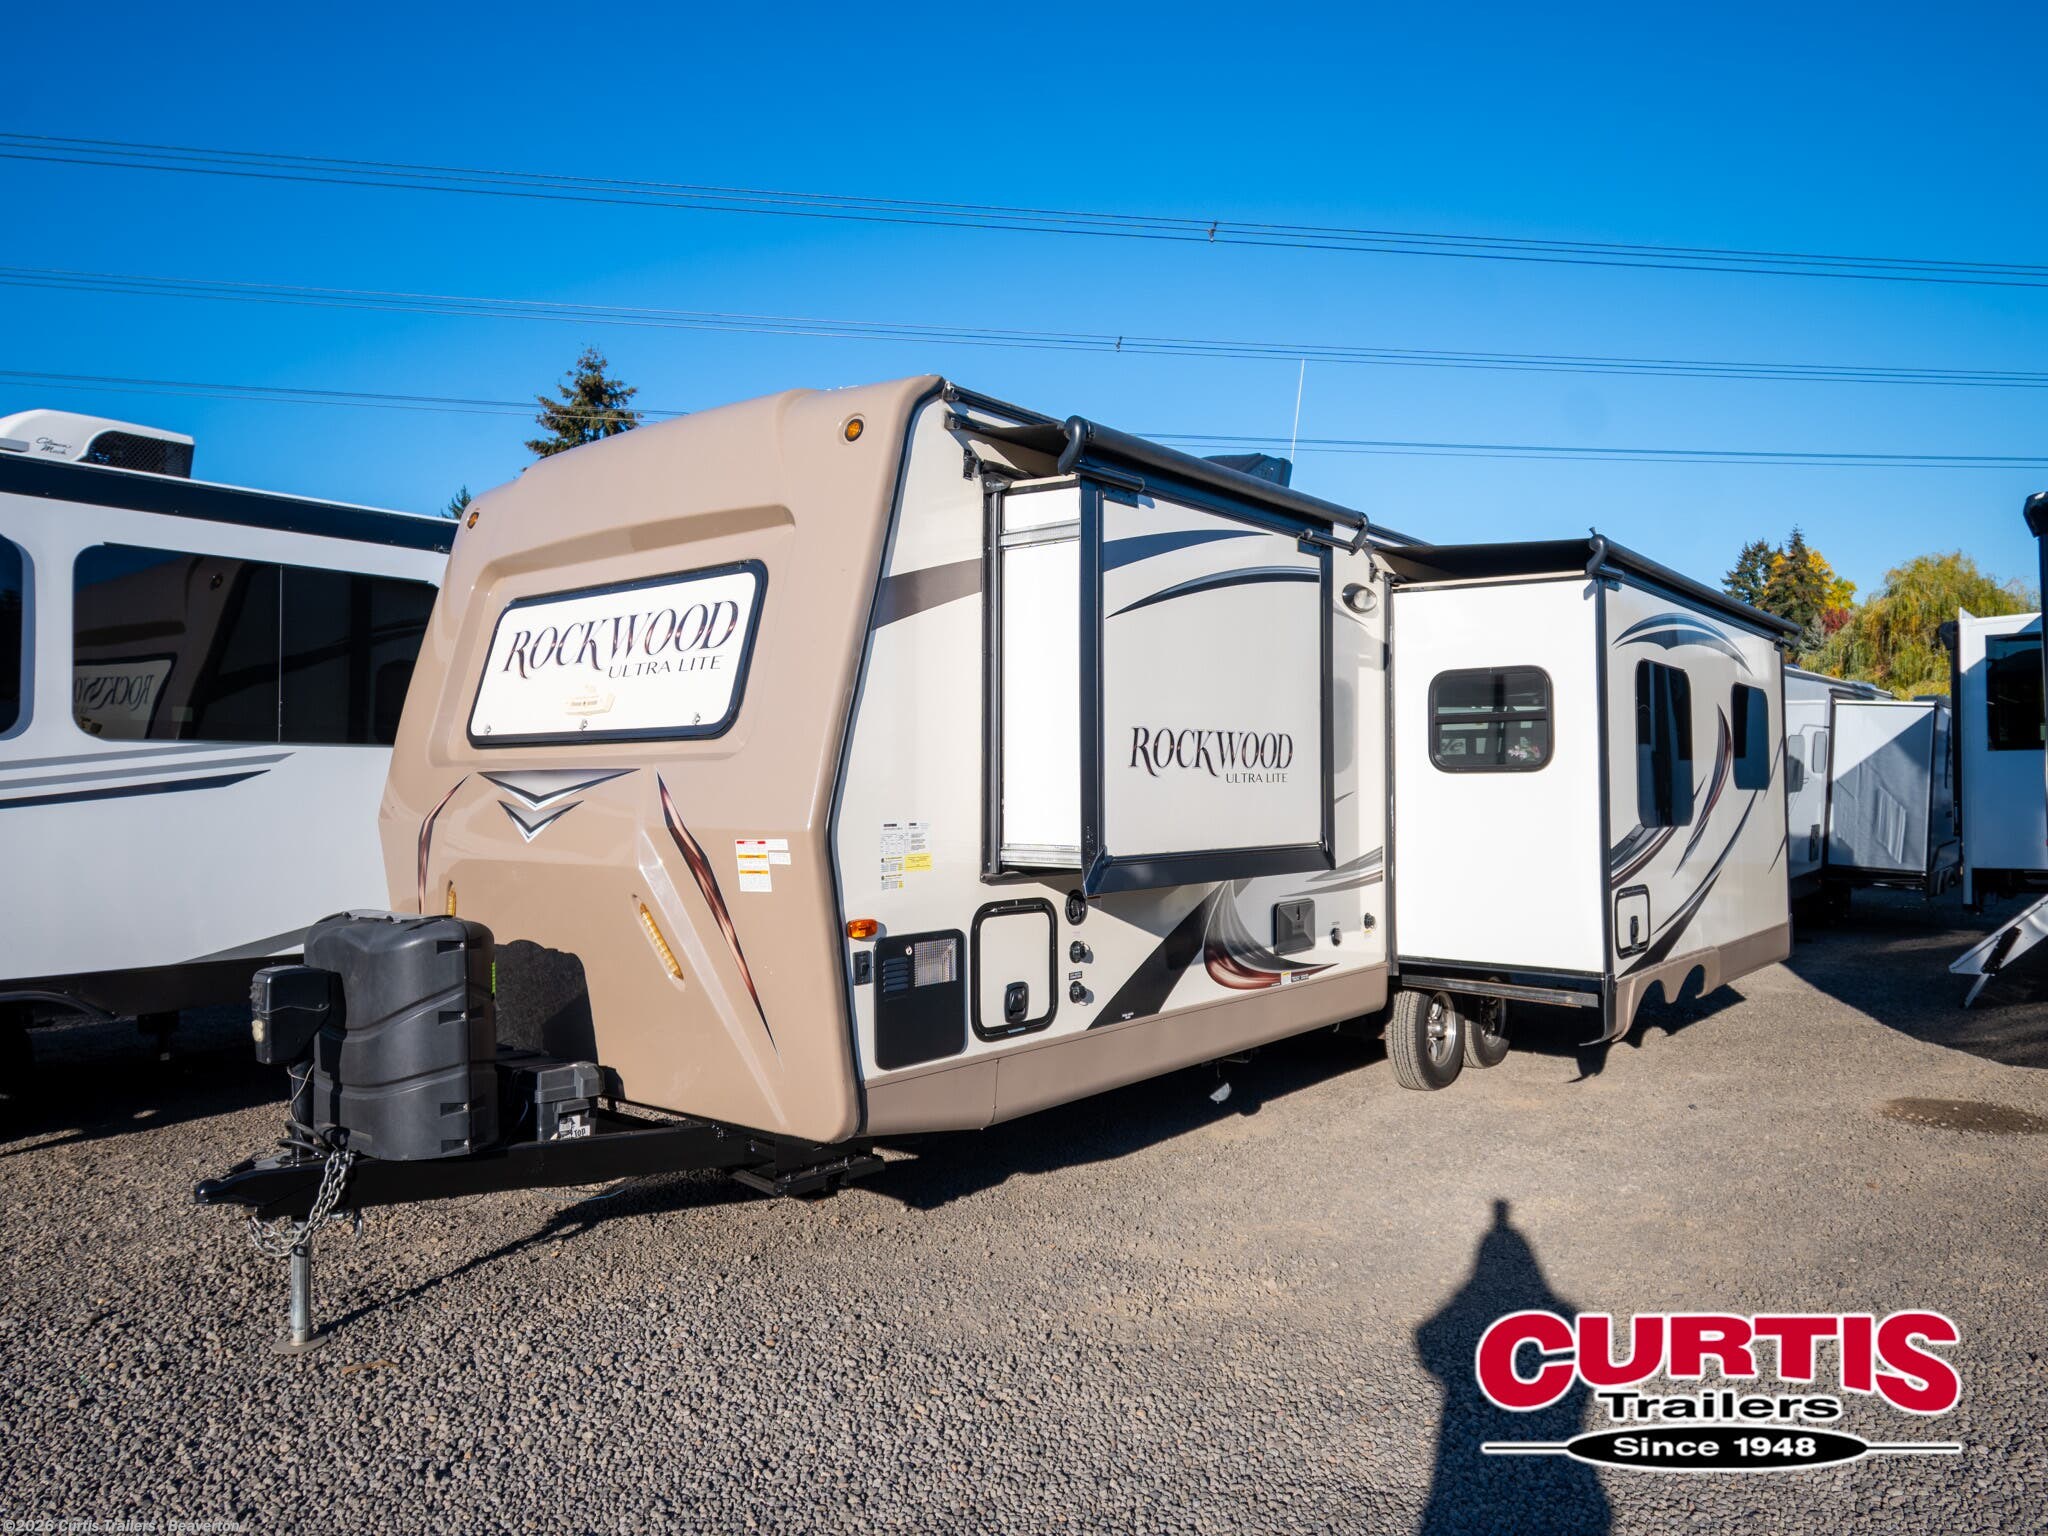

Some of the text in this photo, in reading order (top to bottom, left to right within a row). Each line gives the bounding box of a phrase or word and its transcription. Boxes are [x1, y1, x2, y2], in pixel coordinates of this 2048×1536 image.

[503, 600, 739, 680] ROCKWOOD
[608, 655, 724, 679] ULTRA LITE
[1128, 726, 1294, 777] ROCKWOOD
[1226, 772, 1289, 784] ULTRA LITE
